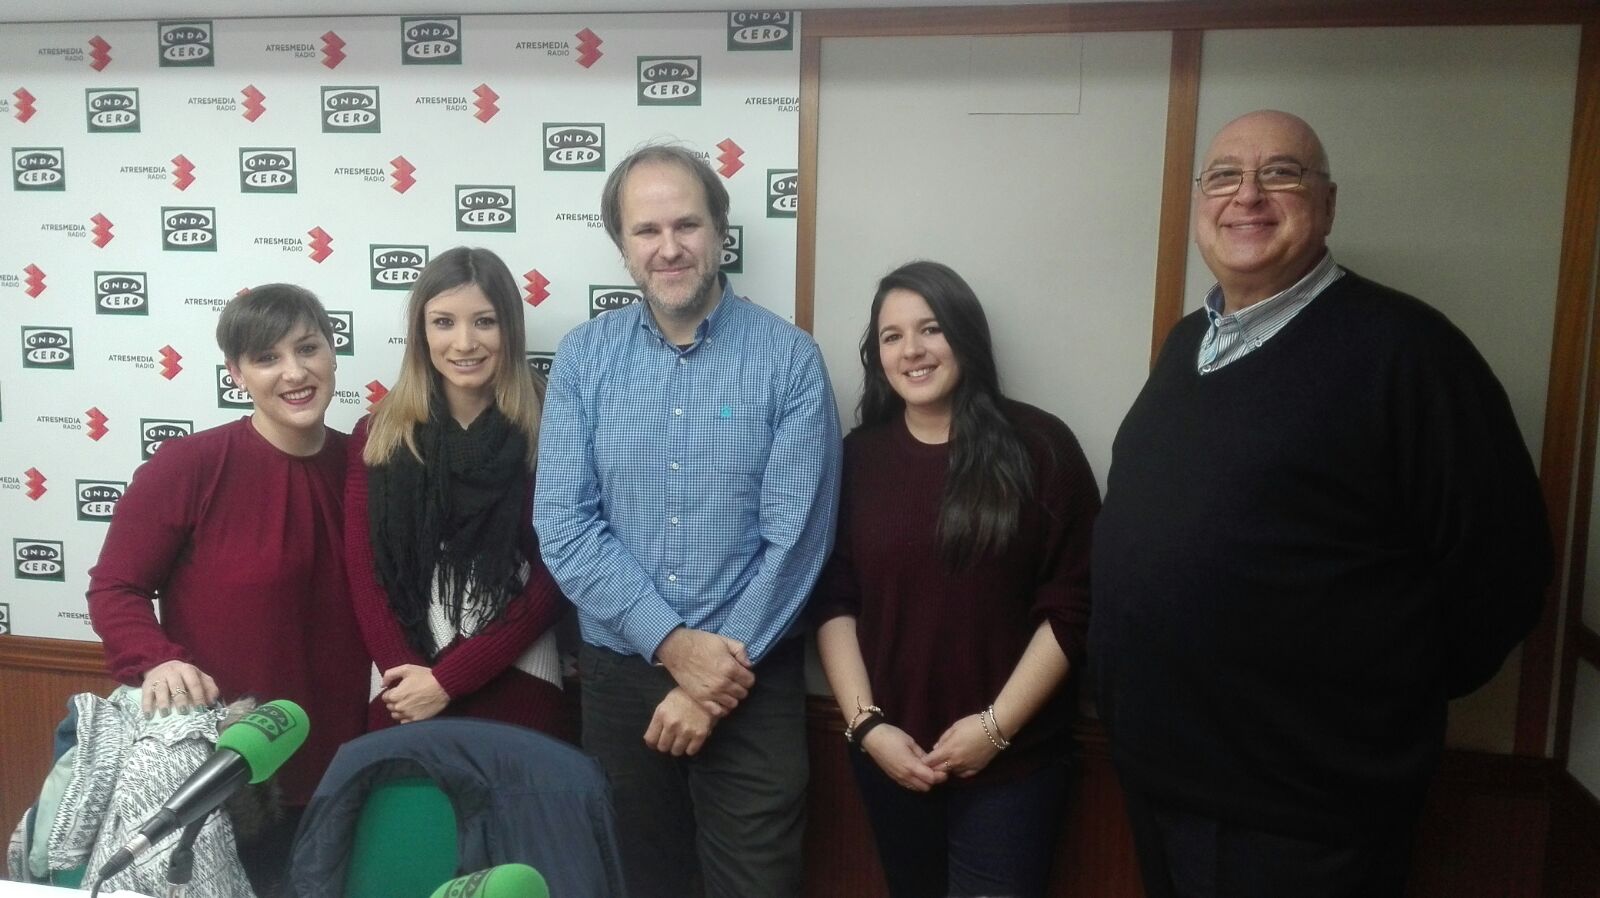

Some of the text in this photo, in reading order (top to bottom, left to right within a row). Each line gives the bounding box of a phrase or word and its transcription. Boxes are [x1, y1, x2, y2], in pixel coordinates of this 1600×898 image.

[738, 12, 781, 22] ONDA
[167, 32, 203, 41] ONDA
[411, 28, 450, 37] ONDA
[740, 28, 781, 40] CERO
[169, 47, 204, 57] CERO
[413, 44, 451, 55] CERO
[648, 68, 689, 78] ONDA
[650, 84, 690, 95] CERO
[94, 98, 130, 107] ONDA
[331, 97, 369, 106] ONDA
[97, 113, 130, 123] CERO
[333, 113, 370, 123] CERO
[553, 134, 593, 144] ONDA
[555, 150, 594, 161] CERO
[20, 158, 55, 166] ONDA
[249, 158, 286, 167] ONDA
[23, 172, 56, 182] CERO
[251, 173, 286, 184] CERO
[777, 181, 797, 192] ON
[465, 196, 504, 205] ONDA
[780, 197, 797, 208] CE
[170, 217, 206, 226] ONDA
[468, 212, 505, 222] CERO
[173, 232, 207, 242] CERO
[380, 255, 418, 264] ONDA
[382, 270, 419, 281] CERO
[103, 282, 138, 290] ONDA
[106, 296, 139, 306] CERO
[599, 297, 639, 305] ONDA
[30, 336, 64, 345] ONDA
[32, 350, 64, 360] CERO
[37, 416, 81, 424] ATRESMEDIA
[149, 429, 184, 437] ONDA
[84, 490, 118, 498] ONDA
[87, 503, 113, 513] CER
[21, 548, 55, 557] ONDA
[24, 562, 55, 571] CERO
